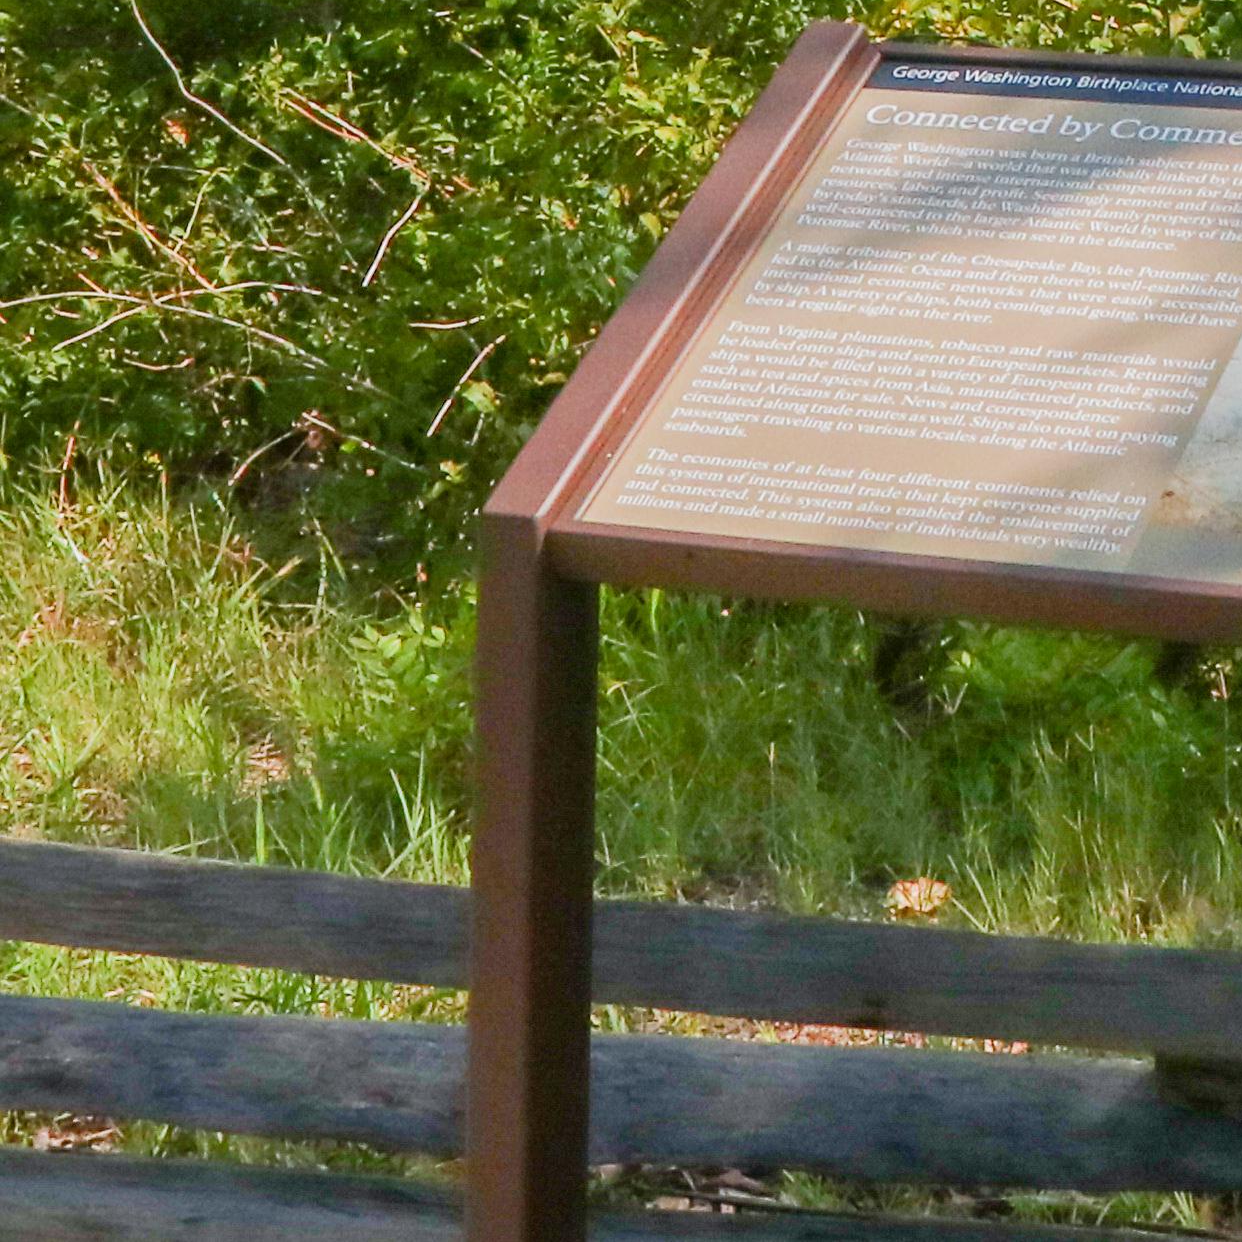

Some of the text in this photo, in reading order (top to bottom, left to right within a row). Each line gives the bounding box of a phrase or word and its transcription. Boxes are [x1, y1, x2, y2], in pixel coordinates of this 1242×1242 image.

[892, 65, 960, 83] George
[964, 69, 1072, 88] Washington
[1076, 75, 1169, 93] Birthplace
[866, 105, 1053, 133] Connected
[1058, 115, 1103, 141] by
[796, 214, 1186, 250] Potomac River, which you can see in the distance.
[805, 202, 924, 218] well-connected
[924, 211, 942, 220] to
[944, 211, 971, 222] the
[973, 213, 1020, 226] larger
[1021, 216, 1080, 229] Atlantic
[1089, 220, 1139, 234] World
[1140, 224, 1157, 235] by
[1164, 228, 1196, 238] way
[1198, 229, 1219, 239] of
[779, 240, 792, 251] A
[796, 244, 843, 255] major
[845, 246, 915, 259] tributary
[918, 251, 939, 261] of
[940, 252, 967, 263] the
[970, 254, 1065, 270] Chesapeake
[1069, 261, 1102, 275] Bay,
[1106, 264, 1134, 276] the
[1137, 266, 1209, 281] Potomac
[744, 293, 992, 322] been a regular sight on the river.
[762, 269, 1242, 312] international economic networks that were easily accessible
[727, 320, 1216, 370] From Virginia plantations, tobacco and raw materials would
[702, 364, 1194, 414] such as tea and spices from Asia, manufactured products, and
[710, 348, 1199, 400] ships would be filled with a variety of European trade goods,
[691, 378, 1120, 423] enslaved Africans for sale. News and correspondence
[665, 421, 747, 435] seaboards.
[670, 407, 1127, 455] passengers traveling to various locales along the Atlantic
[634, 463, 1140, 520] this system of international trade that kept everyone supplied
[647, 448, 1146, 505] The economies of at least four different continents relied on
[616, 494, 681, 508] millions
[683, 501, 718, 512] and
[718, 505, 764, 517] made
[765, 510, 777, 518] a
[780, 511, 825, 523] small
[825, 516, 893, 529] number
[894, 520, 918, 532] of
[916, 523, 1009, 541] individuals
[1013, 534, 1047, 548] very
[624, 479, 1134, 536] and connected. This system also enabled the enslavement of
